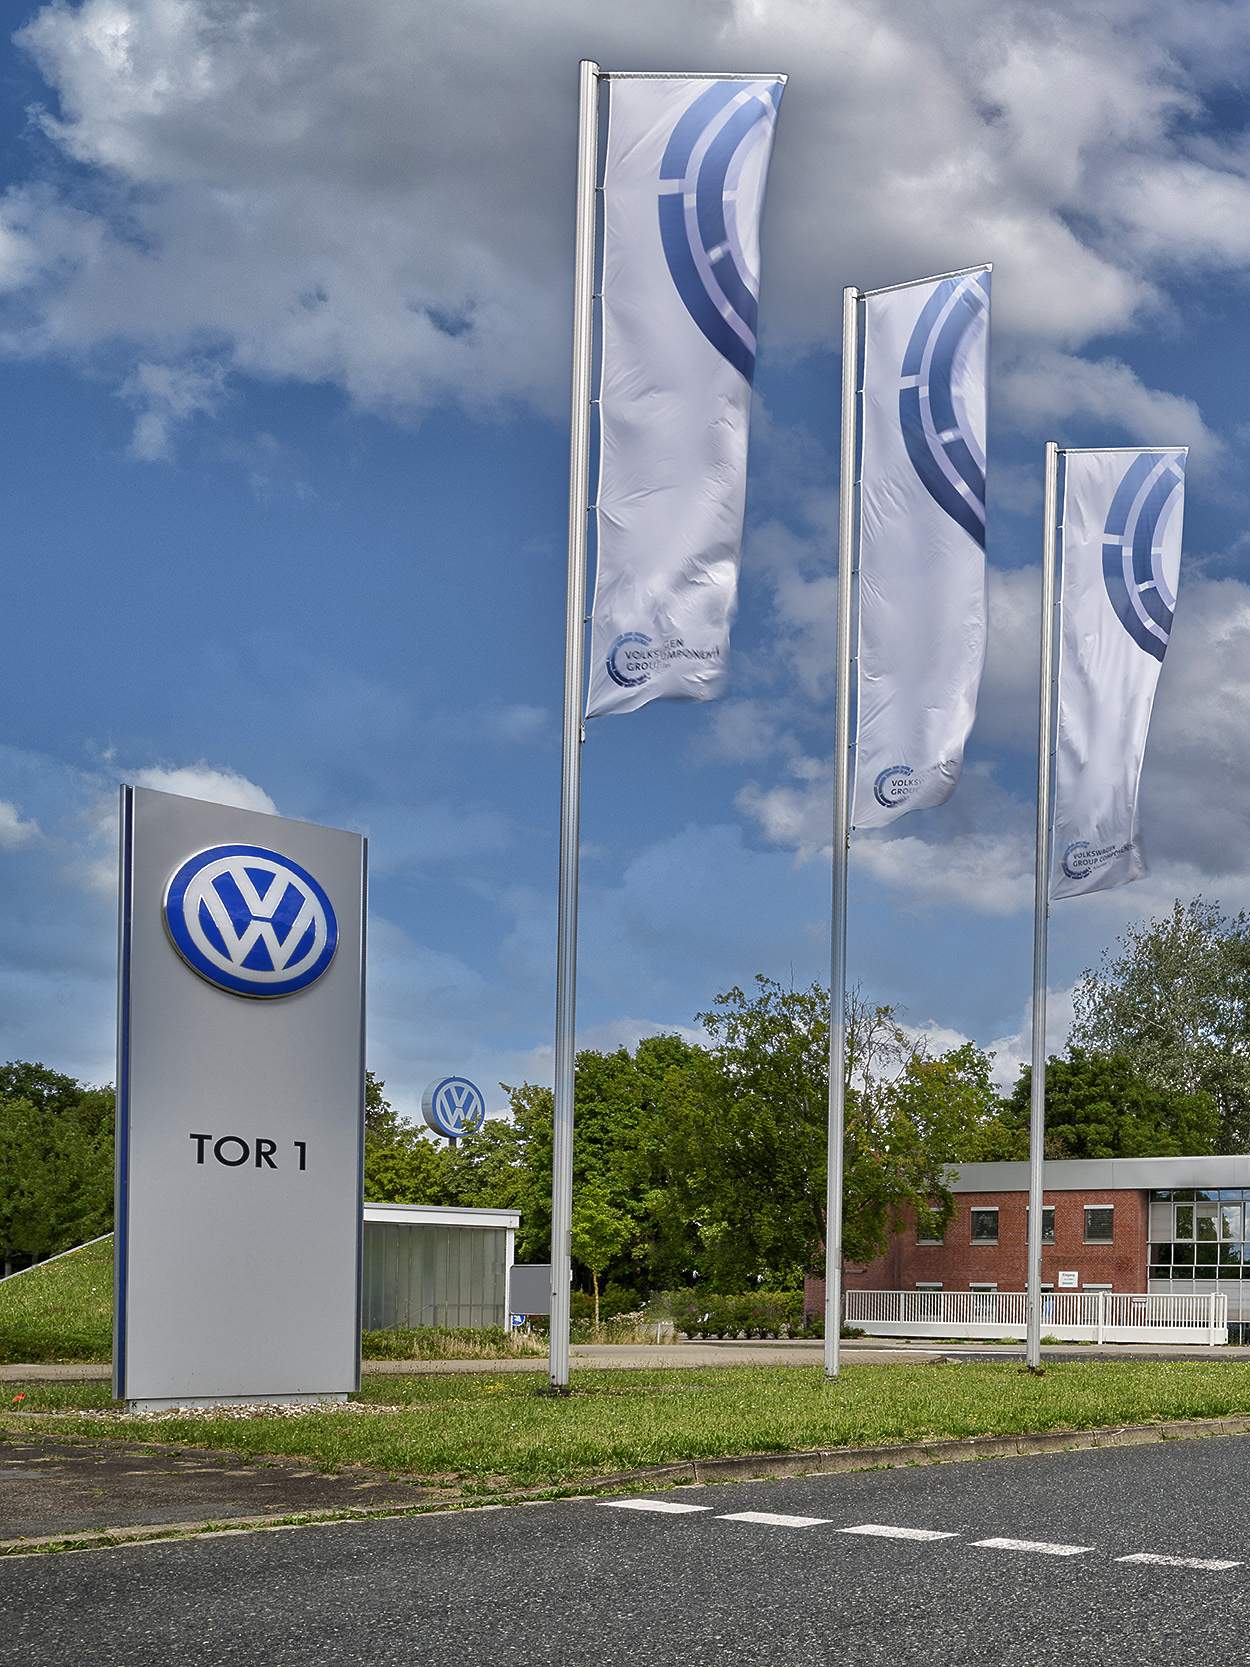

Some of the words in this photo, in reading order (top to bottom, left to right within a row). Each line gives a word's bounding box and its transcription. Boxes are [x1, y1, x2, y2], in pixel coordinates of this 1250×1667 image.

[1072, 858, 1098, 868] GROUP
[190, 1133, 278, 1169] TOR
[294, 1141, 305, 1170] 1
